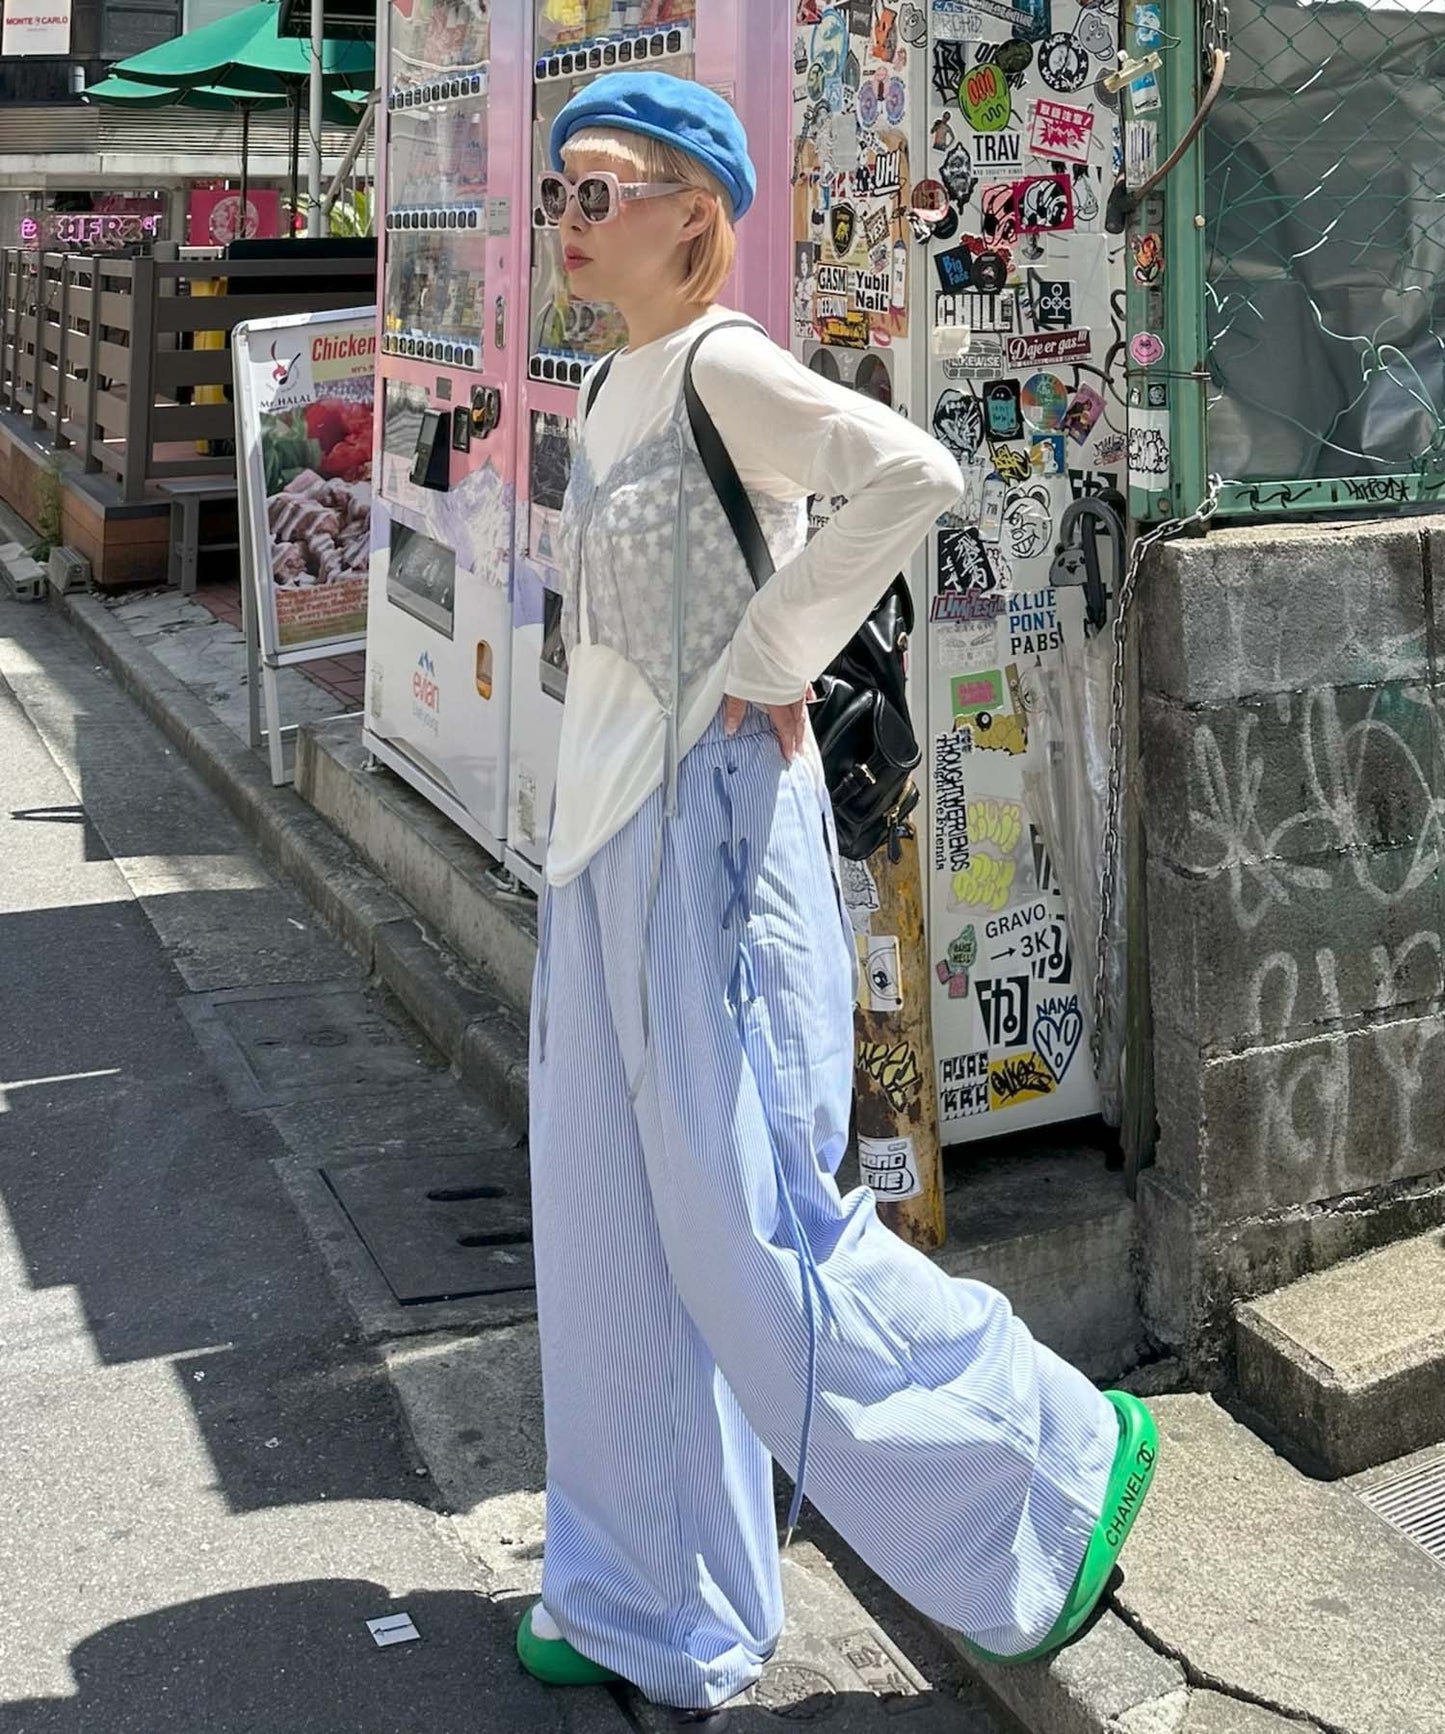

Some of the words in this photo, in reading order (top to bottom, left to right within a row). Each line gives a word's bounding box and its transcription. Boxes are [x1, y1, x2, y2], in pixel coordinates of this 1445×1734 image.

[973, 134, 1020, 161] TRAV
[875, 150, 900, 188] UH!
[817, 267, 846, 293] GASM
[311, 334, 376, 361] Chicken
[1009, 589, 1057, 612] KLUE
[1010, 610, 1057, 634] PONY
[1011, 632, 1059, 655] PABS
[412, 671, 440, 713] evian
[985, 903, 1046, 938] GRAVO
[1105, 1472, 1145, 1547] CHANEL
